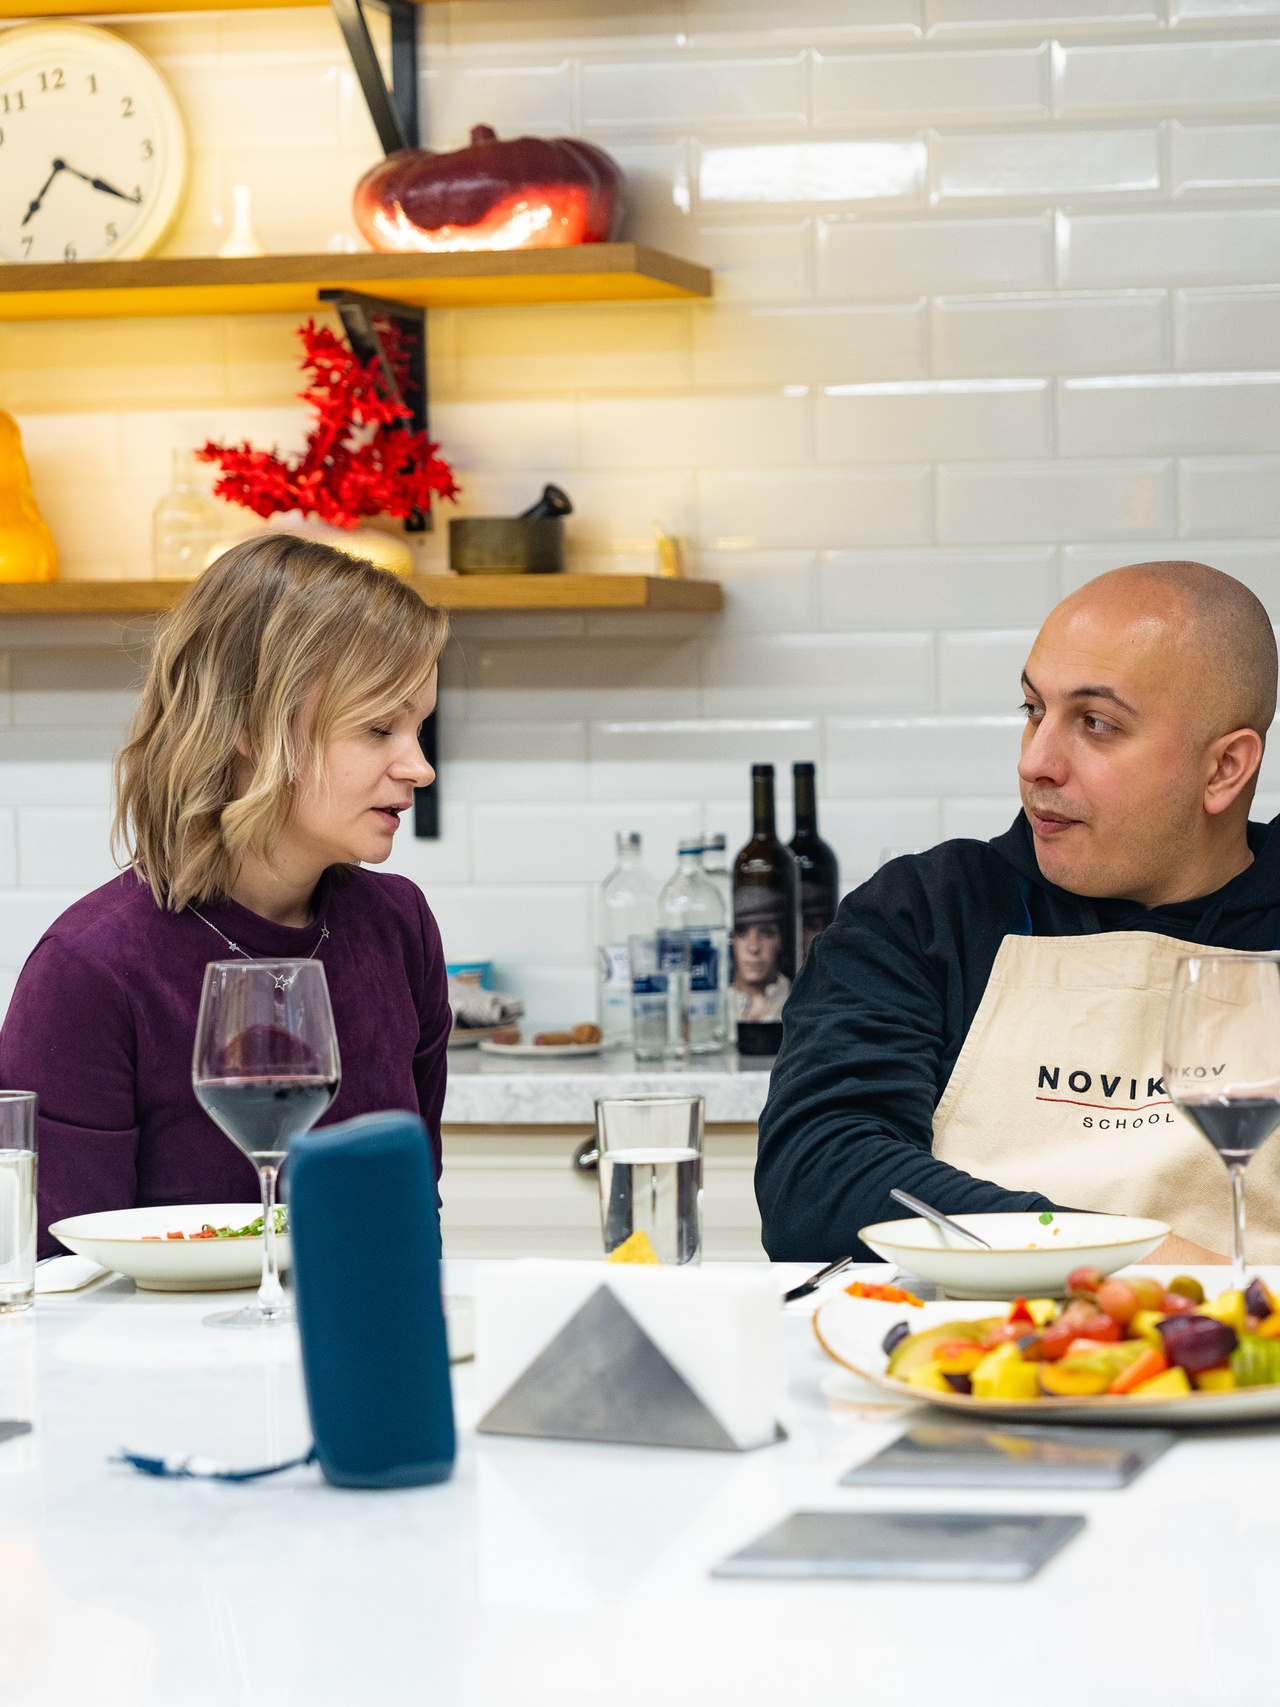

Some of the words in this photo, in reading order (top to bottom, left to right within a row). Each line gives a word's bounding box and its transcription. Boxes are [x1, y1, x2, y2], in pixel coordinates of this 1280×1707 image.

[37, 68, 66, 92] 12
[87, 73, 99, 94] 1
[0, 89, 26, 114] 11
[121, 96, 135, 118] 2
[141, 138, 154, 162] 3
[105, 221, 118, 246] 5
[21, 235, 34, 257] 7
[1082, 1113, 1175, 1130] SCHOOL
